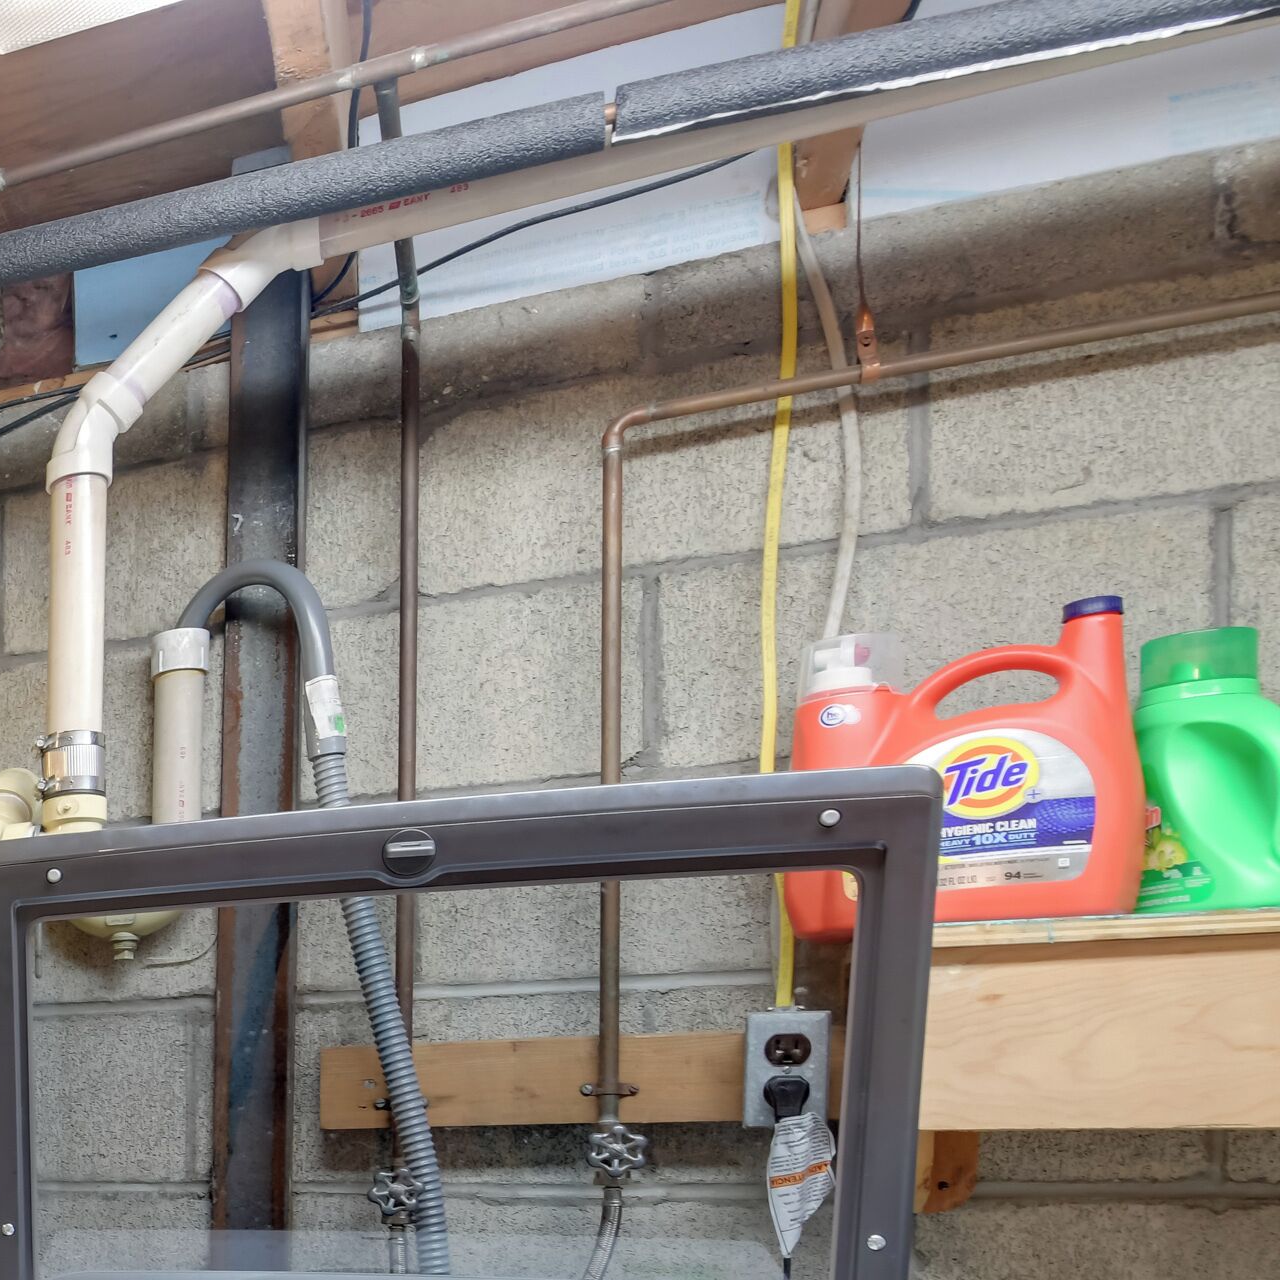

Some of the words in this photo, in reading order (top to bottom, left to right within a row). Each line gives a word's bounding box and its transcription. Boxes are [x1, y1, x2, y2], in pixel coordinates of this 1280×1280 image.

[944, 754, 1029, 806] Tide
[995, 818, 1037, 832] CLEAN
[972, 832, 1008, 846] 10X
[1007, 832, 1036, 841] DUTY
[1004, 871, 1021, 880] 94
